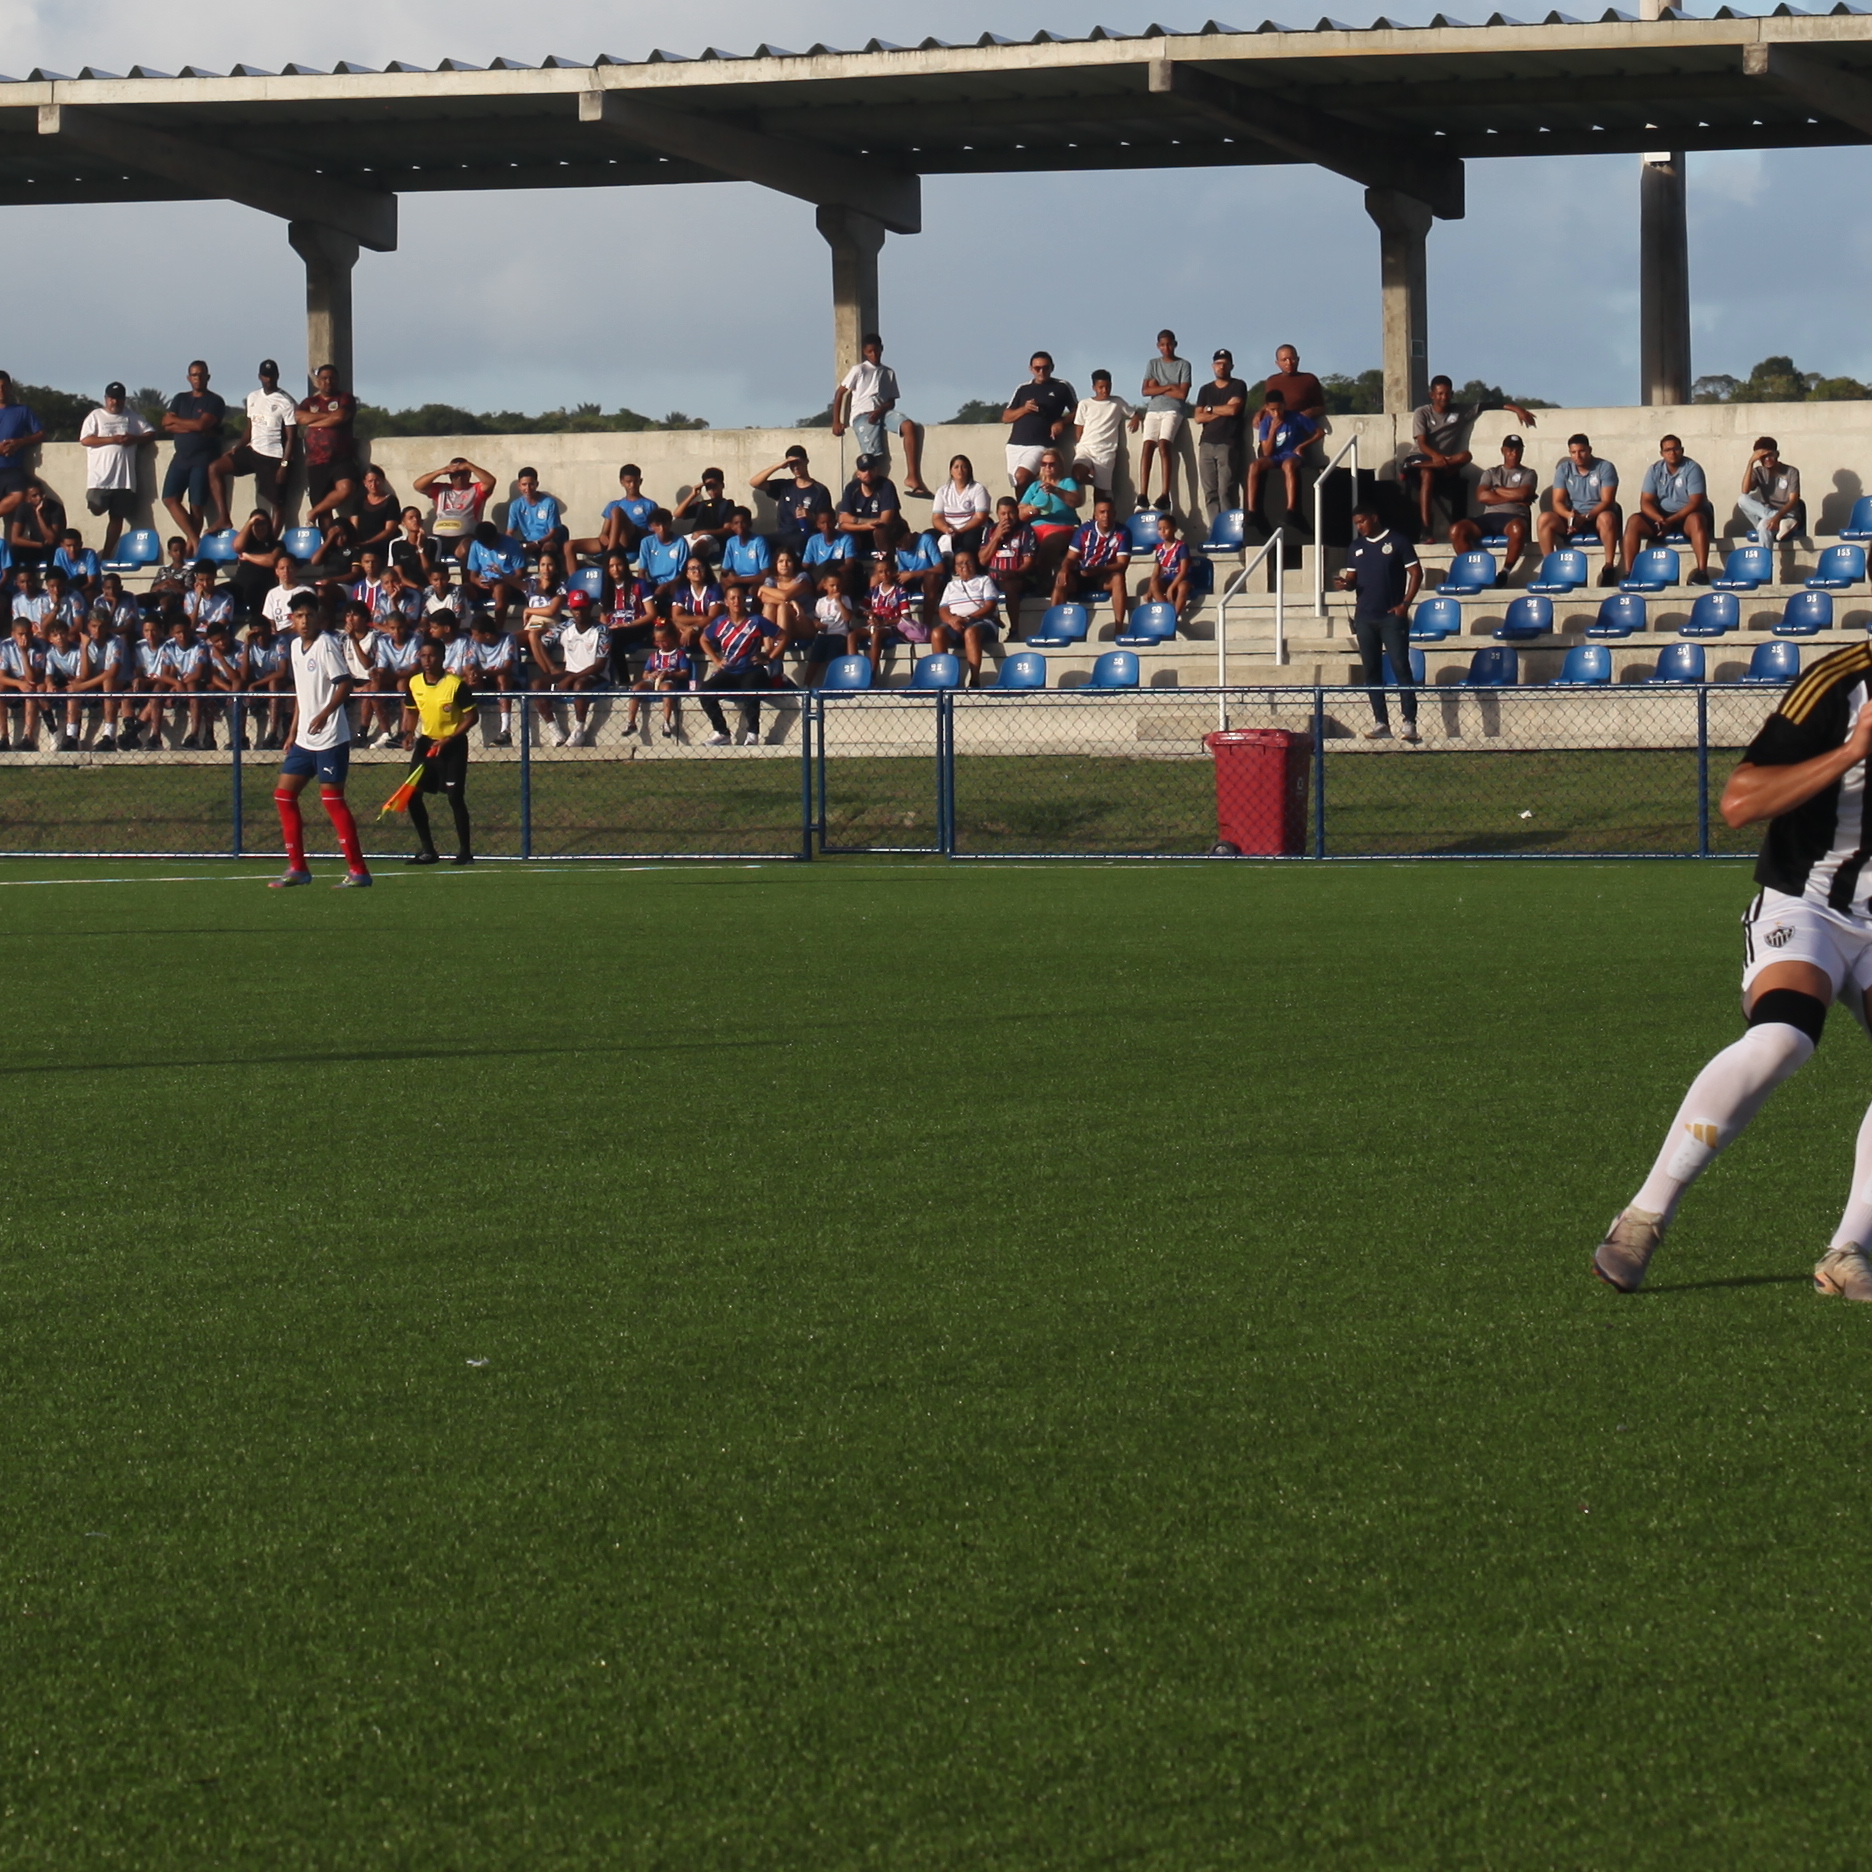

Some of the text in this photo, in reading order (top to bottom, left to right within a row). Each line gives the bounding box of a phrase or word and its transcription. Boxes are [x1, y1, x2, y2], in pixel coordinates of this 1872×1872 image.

[1468, 555, 1481, 563] 151
[1560, 553, 1574, 561] 152
[1771, 645, 1782, 653] 35
[844, 664, 855, 673] 27
